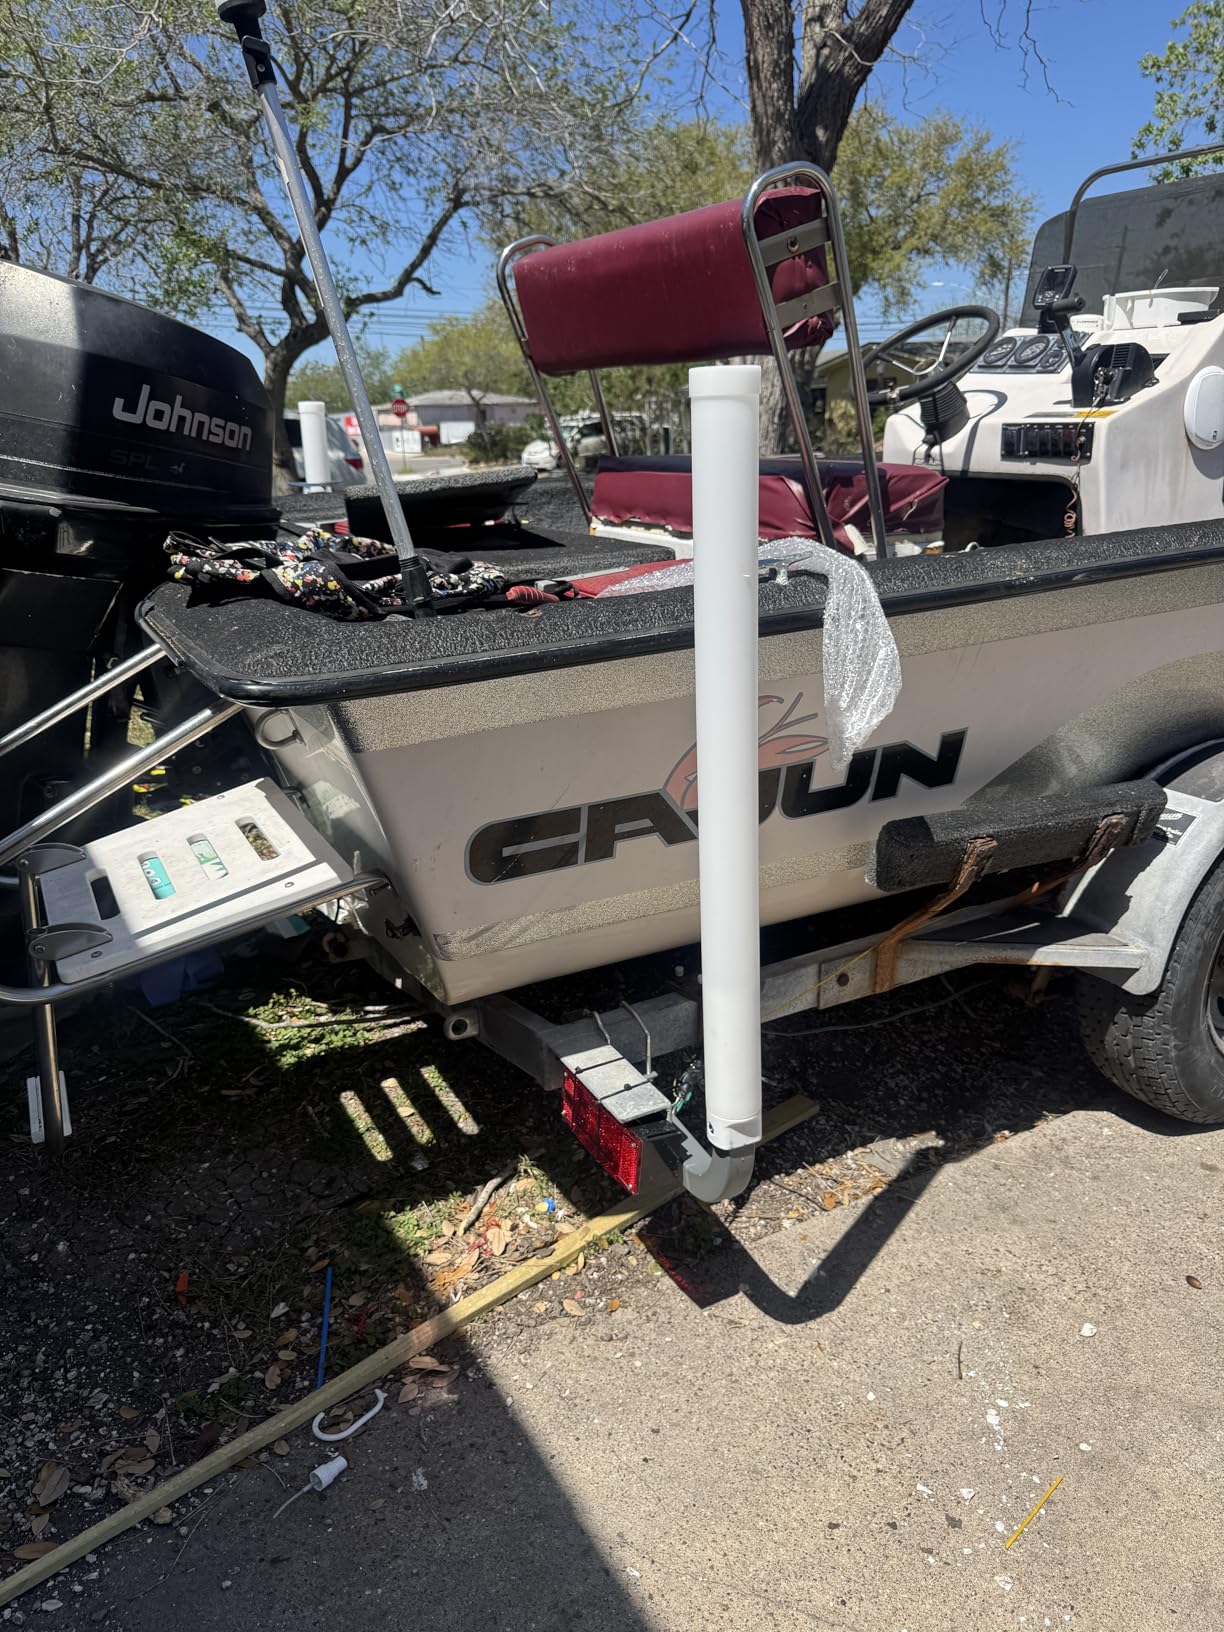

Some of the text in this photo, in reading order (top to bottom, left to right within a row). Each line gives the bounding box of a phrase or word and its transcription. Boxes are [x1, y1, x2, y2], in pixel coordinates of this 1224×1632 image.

[112, 384, 252, 450] Johnson
[392, 404, 408, 413] STOP
[109, 449, 157, 470] SPL
